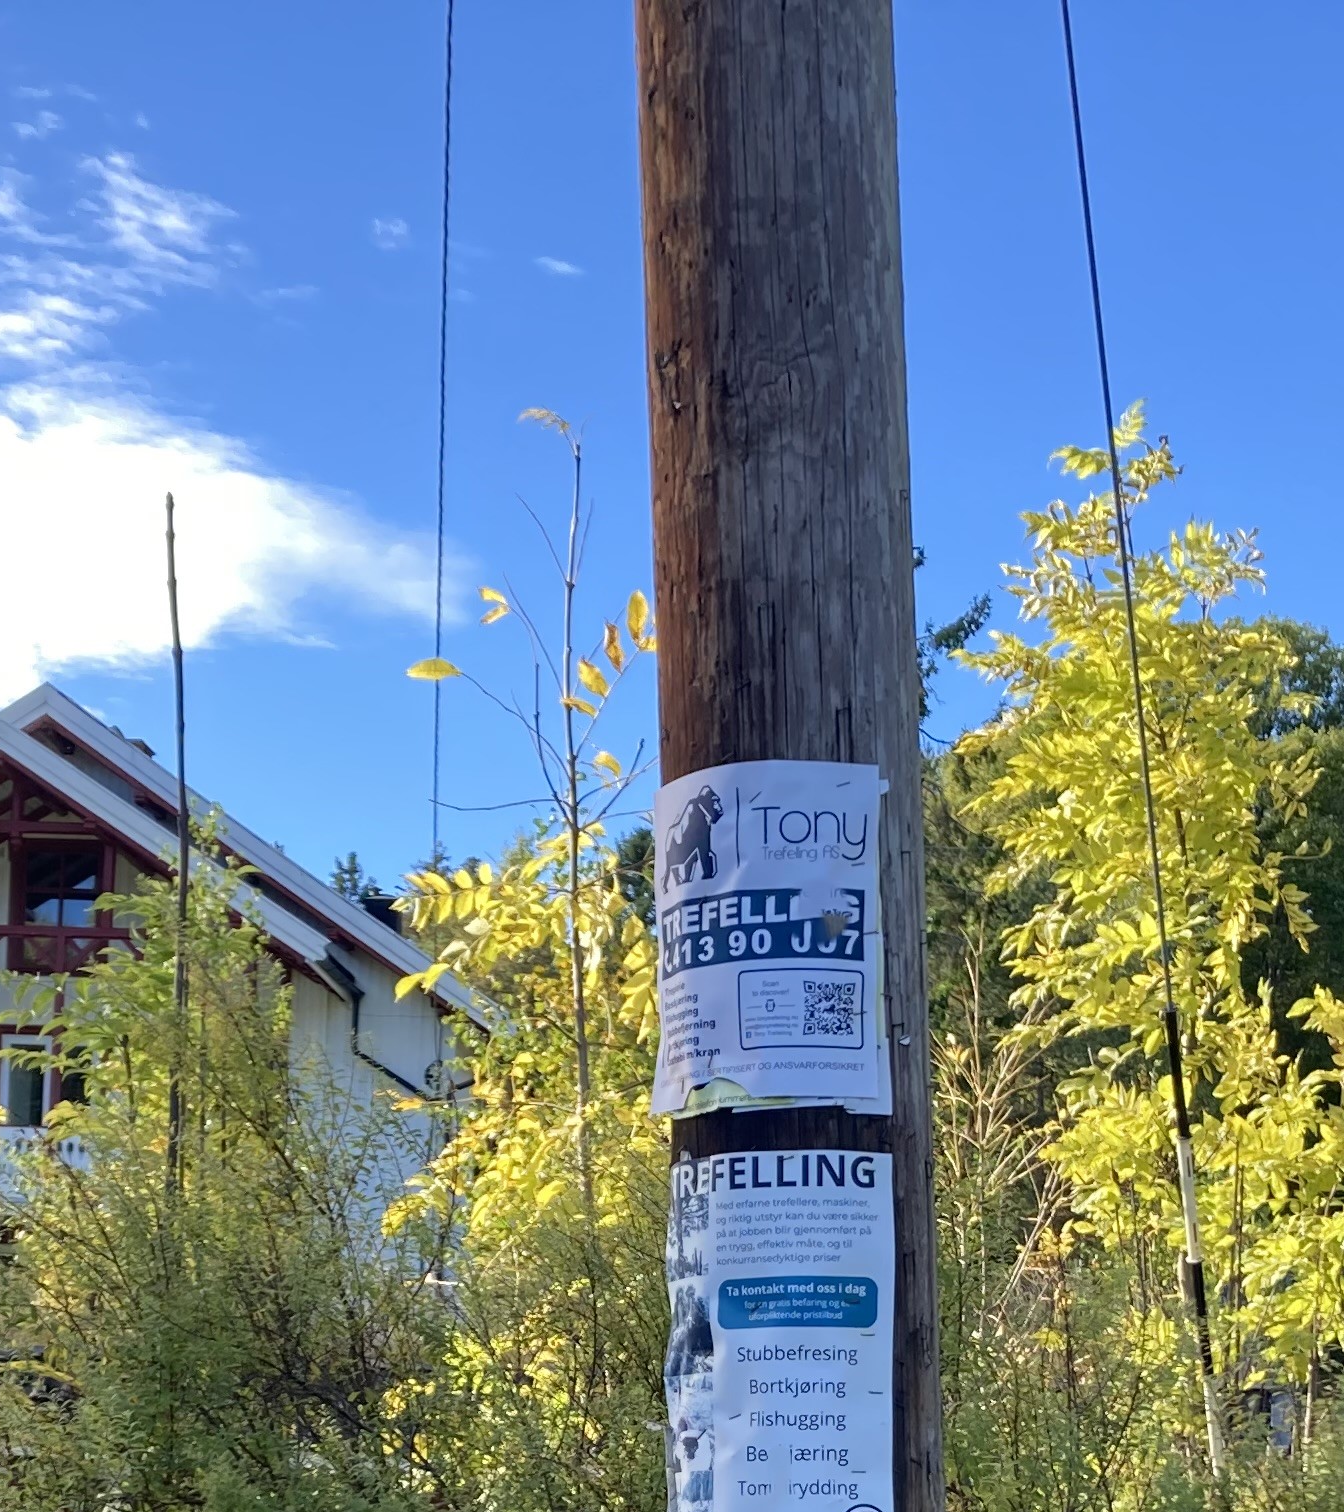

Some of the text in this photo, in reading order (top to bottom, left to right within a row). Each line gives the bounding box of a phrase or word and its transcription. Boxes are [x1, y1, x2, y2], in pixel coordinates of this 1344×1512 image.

[751, 807, 868, 861] Tony
[728, 928, 772, 957] 90
[758, 1061, 771, 1070] OG
[672, 1154, 876, 1199] TREFELLING
[716, 1201, 734, 1210] Med
[735, 1199, 770, 1209] erfarne
[716, 1216, 726, 1225] og
[728, 1214, 752, 1224] riktig
[755, 1213, 782, 1223] utstyr
[785, 1212, 804, 1220] kan
[806, 1212, 821, 1220] du
[850, 1212, 878, 1221] sikker
[716, 1229, 726, 1239] på
[728, 1229, 737, 1237] at
[738, 1227, 772, 1238] jobben
[775, 1226, 790, 1234] blir
[860, 1226, 872, 1236] på
[757, 1239, 793, 1249] effektiv
[827, 1240, 840, 1249] og
[843, 1239, 852, 1248] til
[716, 1253, 841, 1266] konkurransedyktige priser
[726, 1286, 739, 1297] Ta
[741, 1283, 785, 1296] kontakt
[787, 1282, 814, 1293] med
[816, 1284, 836, 1293] oss
[844, 1283, 867, 1297] dag
[792, 1298, 827, 1309] befaring
[828, 1300, 841, 1309] og
[737, 1344, 857, 1365] Stubbefresing
[749, 1377, 846, 1398] Bortkjøring
[749, 1410, 846, 1431] Flishugging
[746, 1444, 849, 1466] Bejæring
